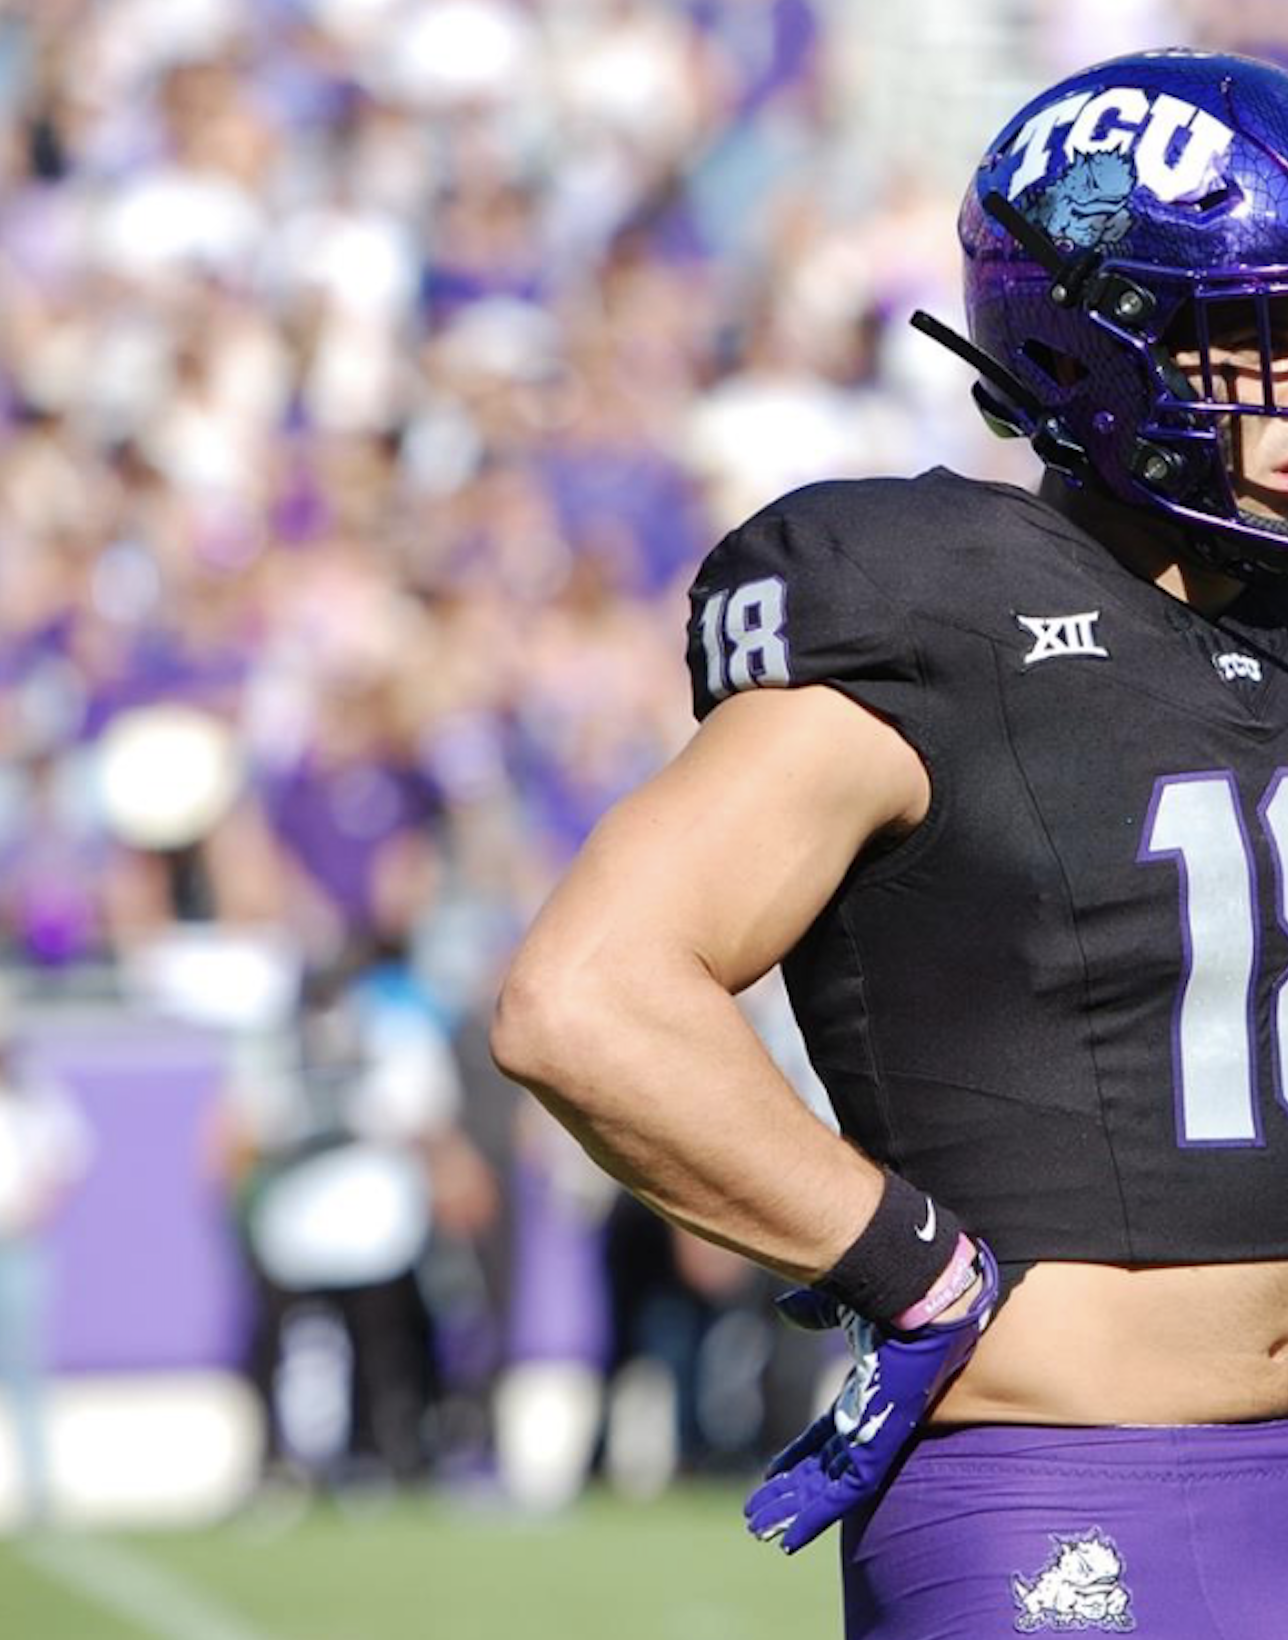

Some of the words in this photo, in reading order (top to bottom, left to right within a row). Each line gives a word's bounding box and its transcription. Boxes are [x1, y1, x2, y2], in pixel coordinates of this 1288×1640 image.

[1006, 87, 1236, 203] TCU
[699, 576, 790, 698] 18
[1016, 609, 1109, 664] XII
[1218, 652, 1262, 681] TCU
